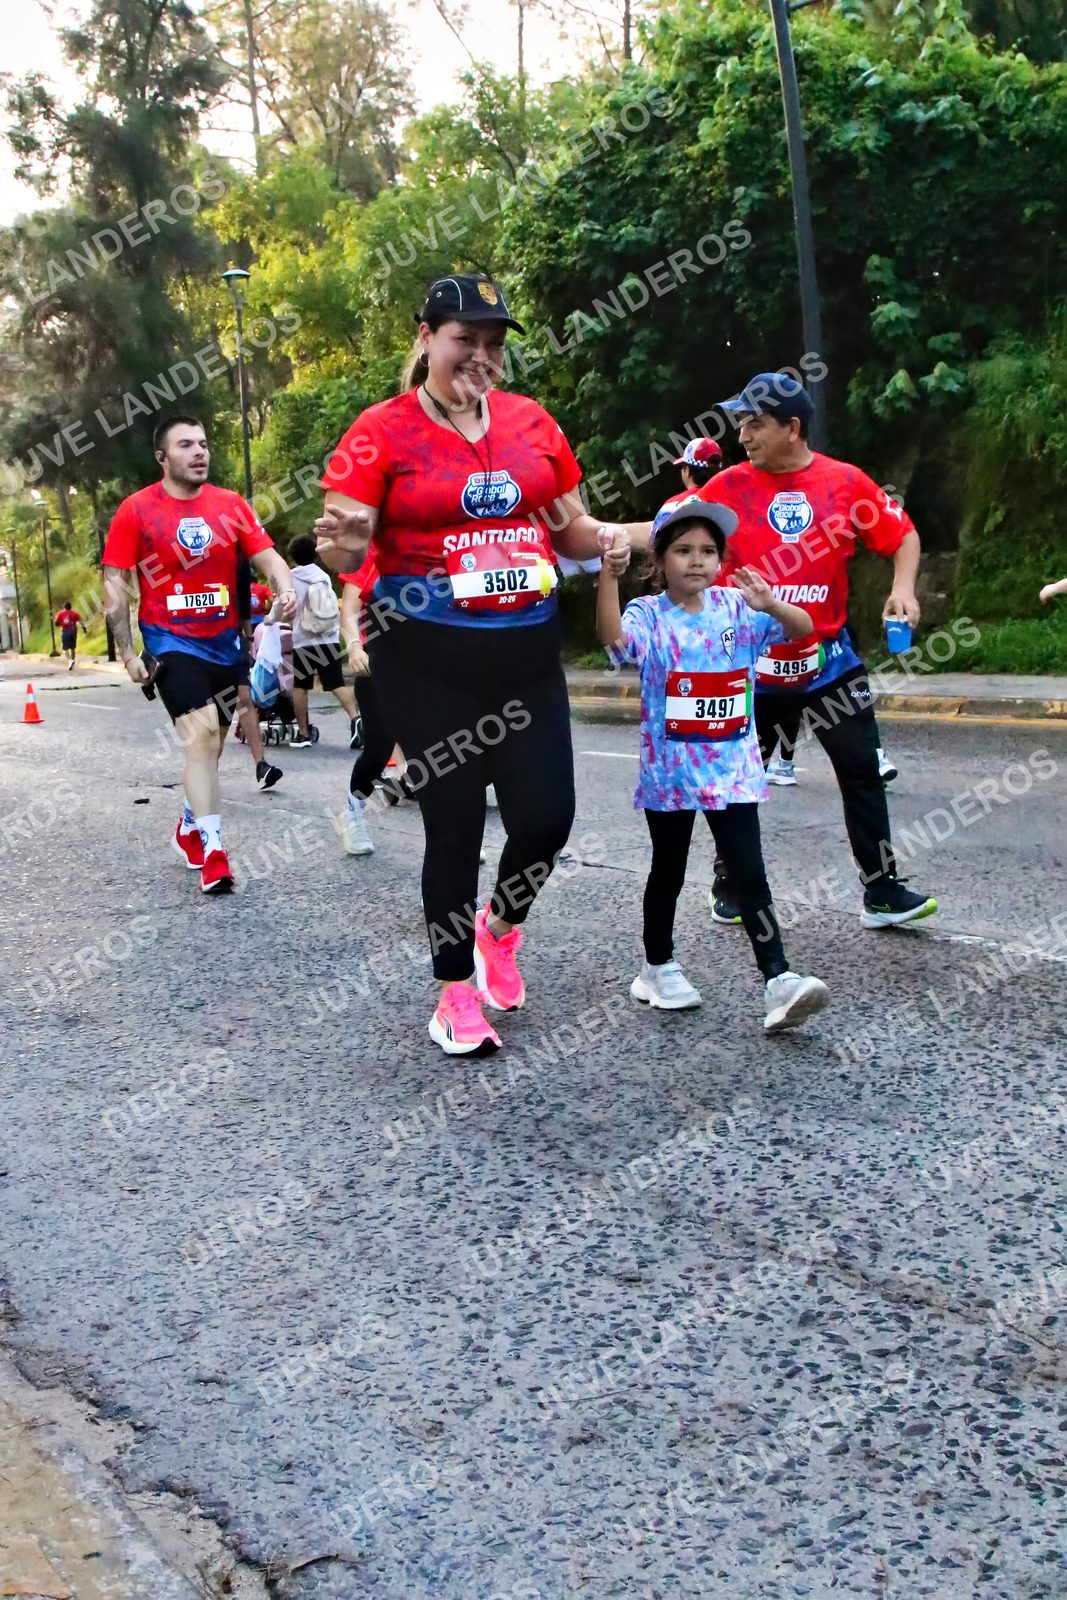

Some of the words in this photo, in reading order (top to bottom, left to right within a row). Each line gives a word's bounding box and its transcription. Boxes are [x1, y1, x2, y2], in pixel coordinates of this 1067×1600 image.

[477, 484, 506, 495] Gobal
[443, 527, 538, 555] SANTIAGO
[484, 569, 528, 593] 3502
[184, 593, 215, 608] 17620
[770, 585, 829, 603] NTIAGO
[773, 659, 808, 675] 3495
[695, 698, 735, 718] 3497
